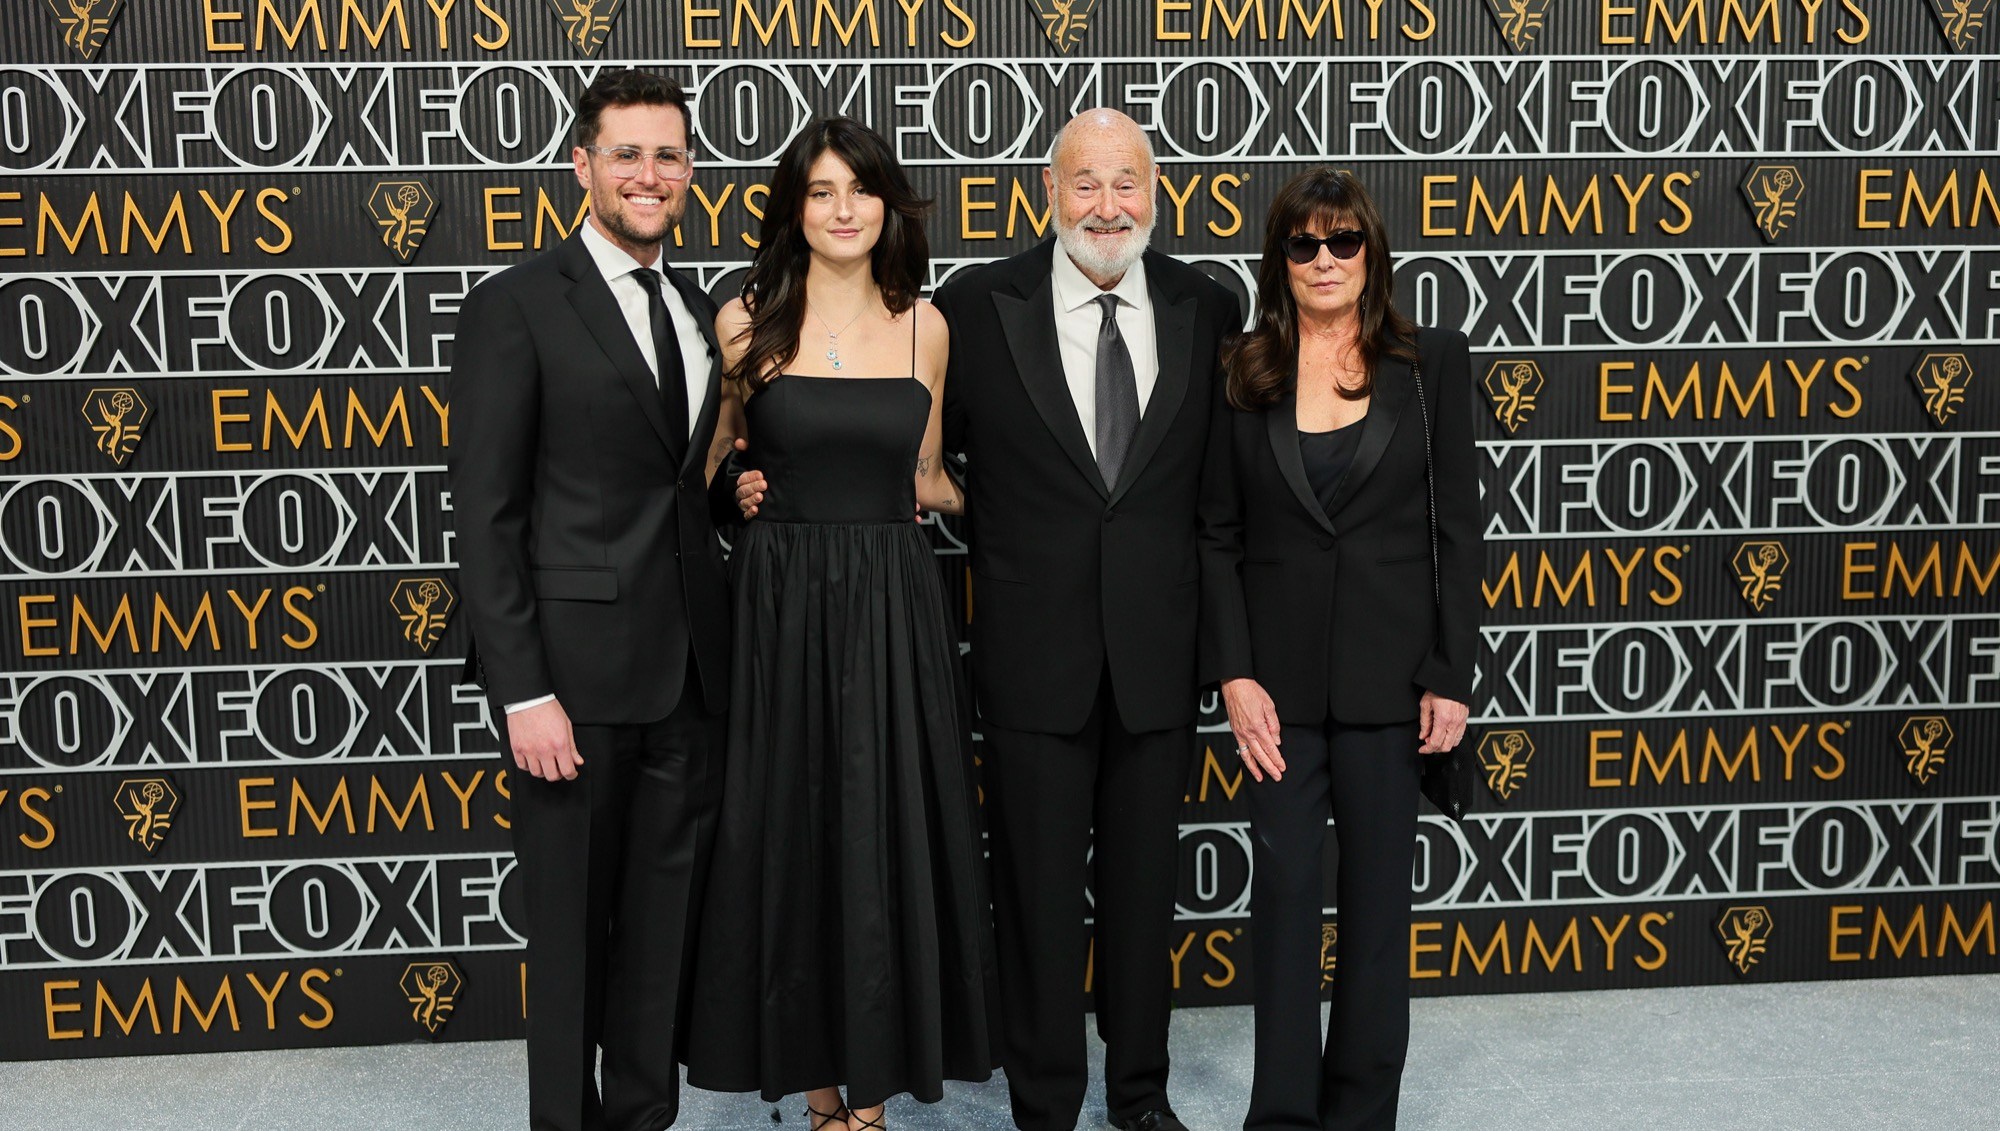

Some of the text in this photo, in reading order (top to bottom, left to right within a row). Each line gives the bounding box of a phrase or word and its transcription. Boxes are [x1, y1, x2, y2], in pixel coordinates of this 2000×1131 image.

[204, 0, 510, 52] EMMYS
[684, 0, 976, 48] EMMYS
[1155, 0, 1436, 41] EMMYS
[1601, 0, 1870, 44] EMMYS
[140, 62, 399, 174] FOX
[1322, 56, 1547, 161] FOX
[1544, 55, 1767, 159] FOX
[1758, 54, 1979, 158] FOX
[484, 183, 771, 251] EMYS
[960, 173, 1243, 240] EMYS
[1421, 172, 1693, 237] EMMYS
[155, 268, 409, 378] FOX
[1391, 249, 1544, 352] OX
[1537, 248, 1760, 350] FOX
[1751, 246, 1970, 348] FOX
[212, 385, 449, 452] EMMY
[1600, 357, 1863, 421] EMMYS
[0, 472, 183, 577] OX
[171, 468, 420, 574] FOX
[1535, 436, 1753, 539] FOX
[1746, 433, 1961, 534] FOX
[1482, 546, 1683, 609] MMYS
[19, 587, 318, 657] EMMYS
[187, 661, 431, 769] FOX
[1531, 620, 1746, 722] FOX
[1738, 615, 1952, 715] FOX
[1589, 723, 1846, 787] EMMYS
[201, 857, 441, 962] FOX
[1411, 814, 1532, 911] OX
[1526, 804, 1740, 903] FOX
[1731, 798, 1943, 897] FOX
[1409, 912, 1668, 979] EMMYS
[44, 968, 335, 1040] EMMYS
